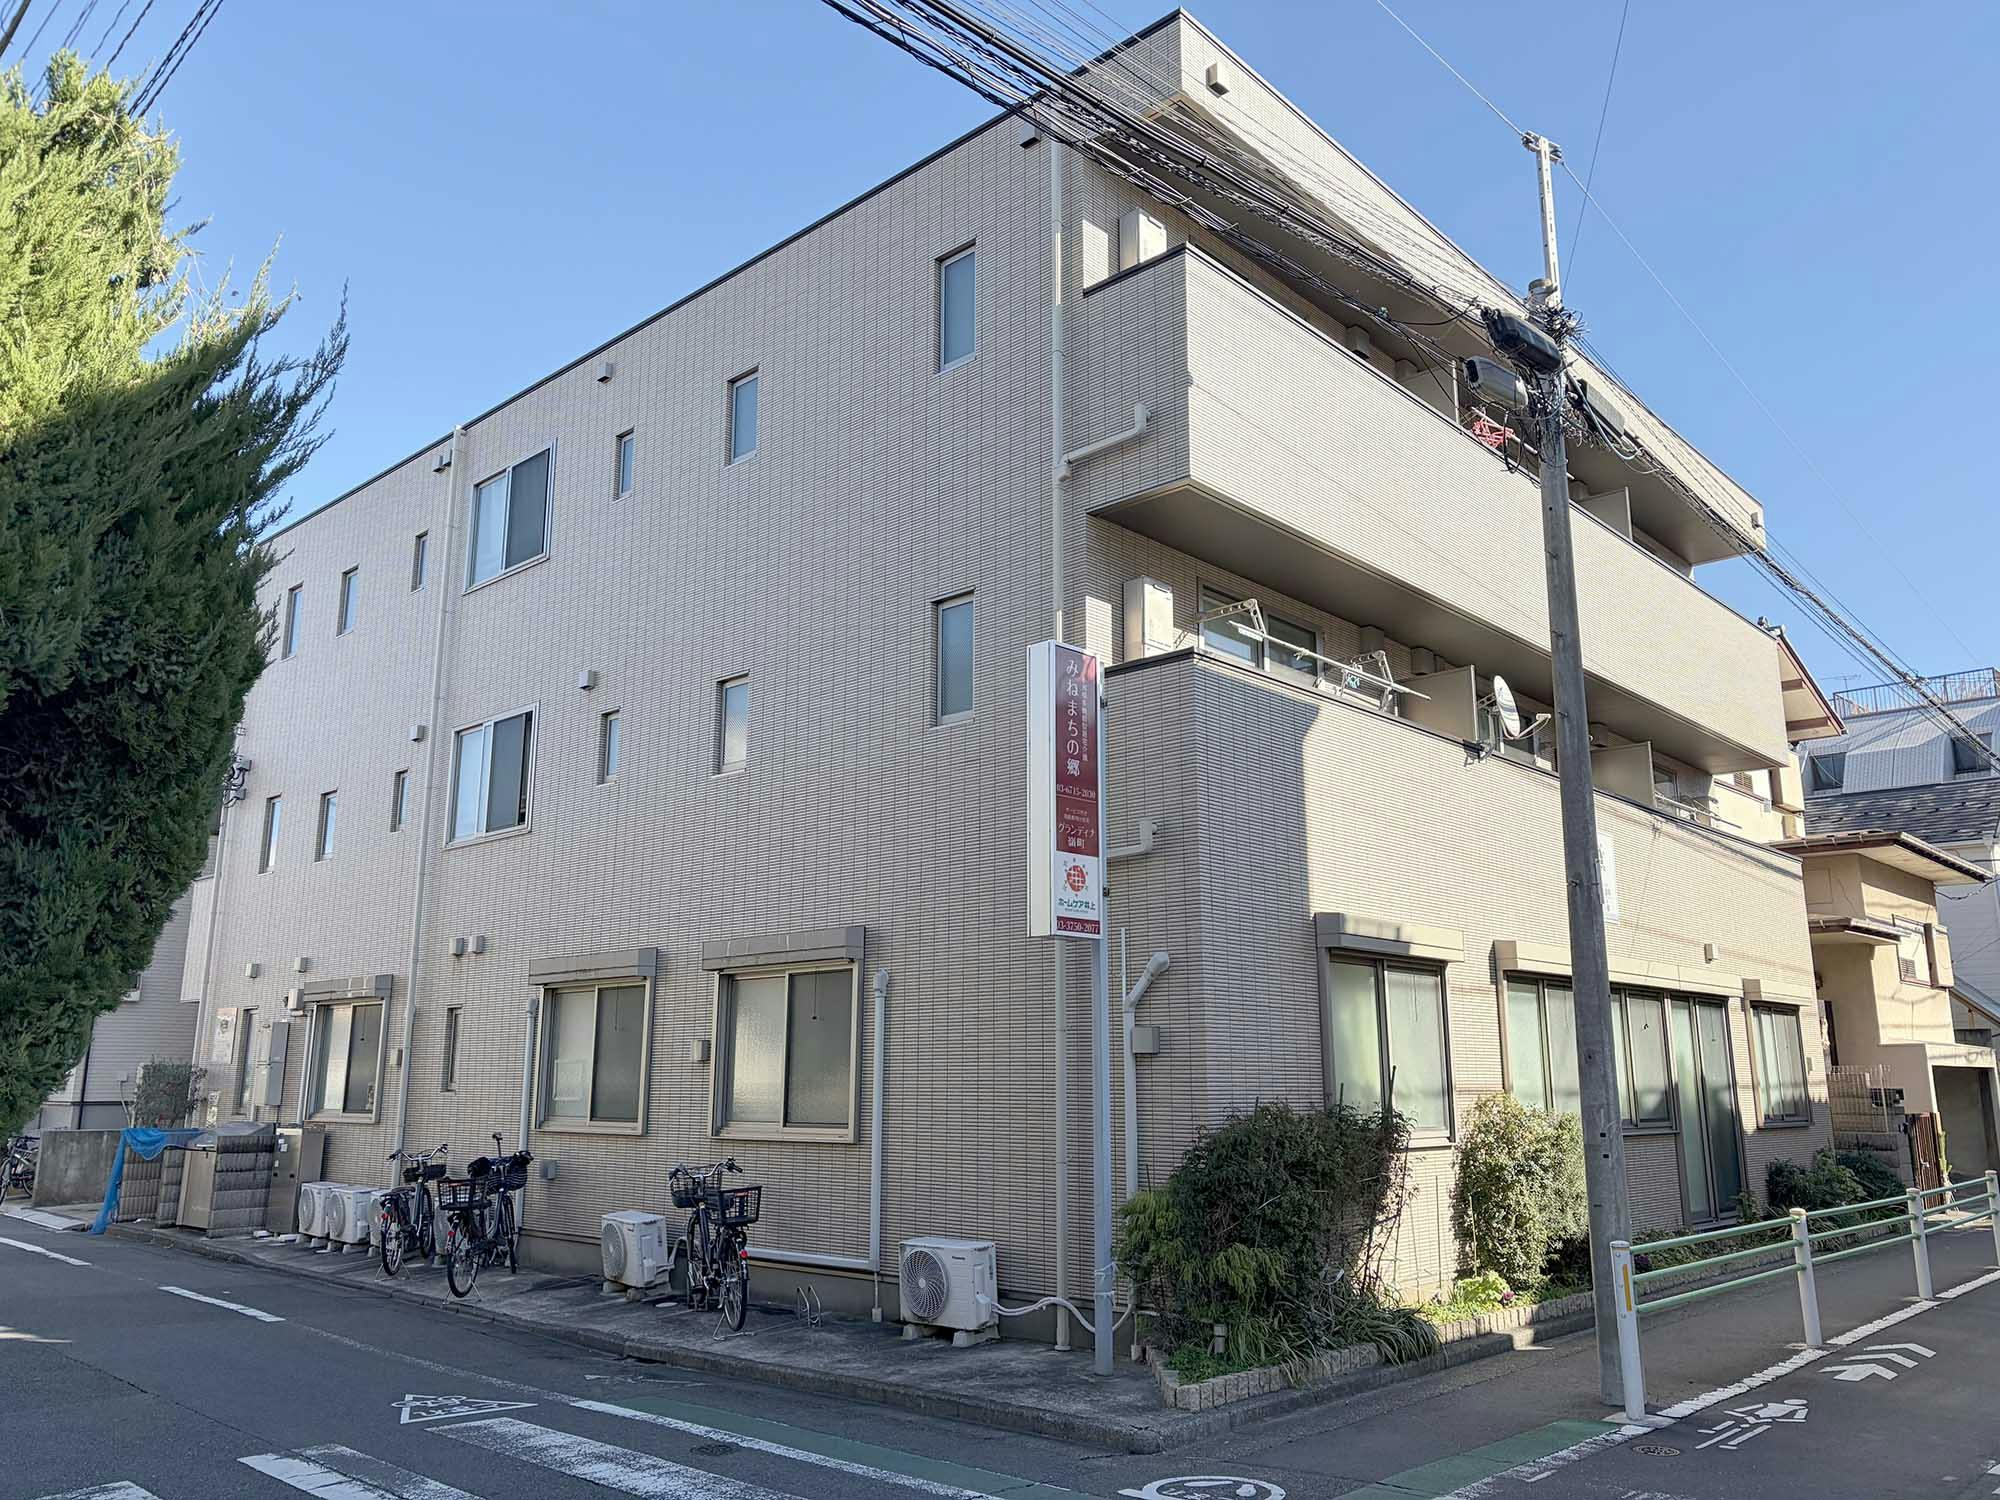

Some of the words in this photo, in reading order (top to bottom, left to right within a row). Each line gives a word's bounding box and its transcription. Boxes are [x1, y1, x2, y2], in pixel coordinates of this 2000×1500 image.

[1065, 659, 1080, 776] みねまちの郷
